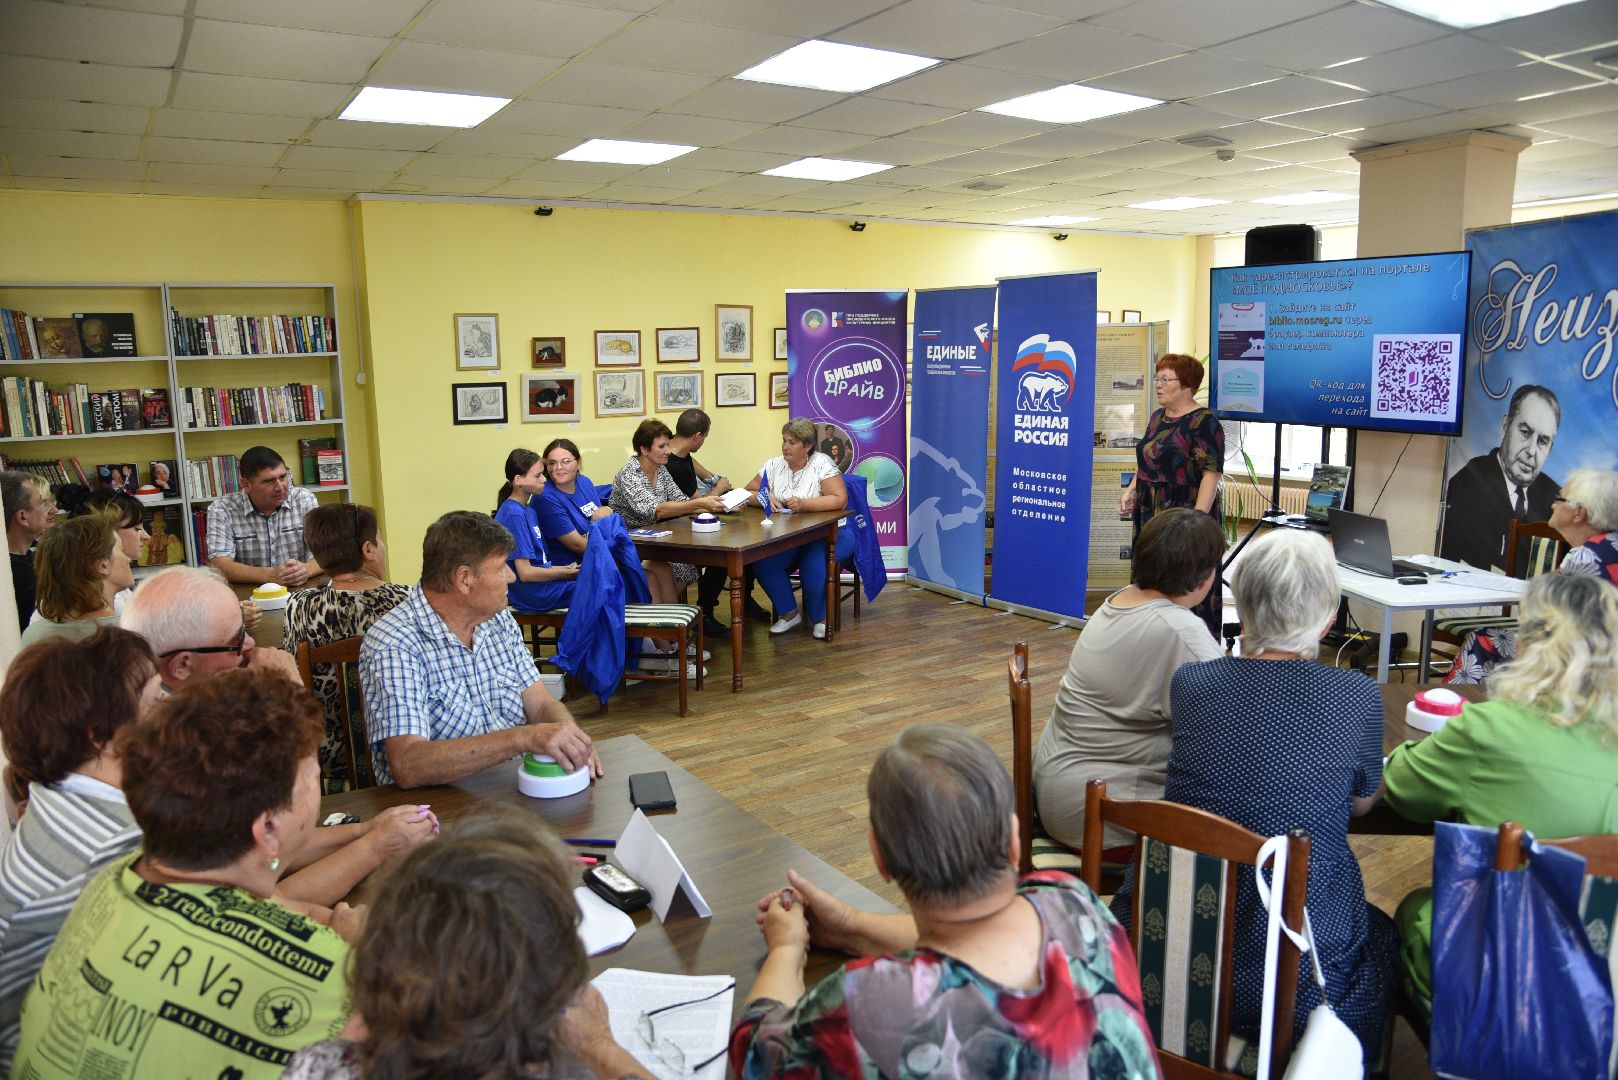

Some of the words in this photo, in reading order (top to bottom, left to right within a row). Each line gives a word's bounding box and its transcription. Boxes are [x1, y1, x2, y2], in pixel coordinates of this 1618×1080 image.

[1361, 266, 1375, 276] на
[1380, 263, 1430, 275] портале
[1334, 301, 1357, 312] сайт
[926, 345, 977, 362] ЕДИНЫЕ
[823, 358, 883, 384] БИБЛИО
[824, 379, 885, 400] ДРАЙВ
[1309, 379, 1345, 391] QR-код
[1346, 382, 1367, 391] для
[1318, 393, 1366, 404] перехода
[91, 392, 104, 431] РУССКИЙ
[112, 392, 123, 430] КОСТЮМ
[1331, 408, 1344, 416] на
[1345, 406, 1369, 417] сайт
[1014, 414, 1069, 430] ЕДИНАЯ
[1014, 429, 1069, 447] РОССИЯ
[1013, 467, 1067, 482] Московское
[1012, 481, 1067, 496] областное
[1012, 495, 1066, 509] региональное
[1011, 508, 1066, 523] отделение
[160, 946, 193, 987] R
